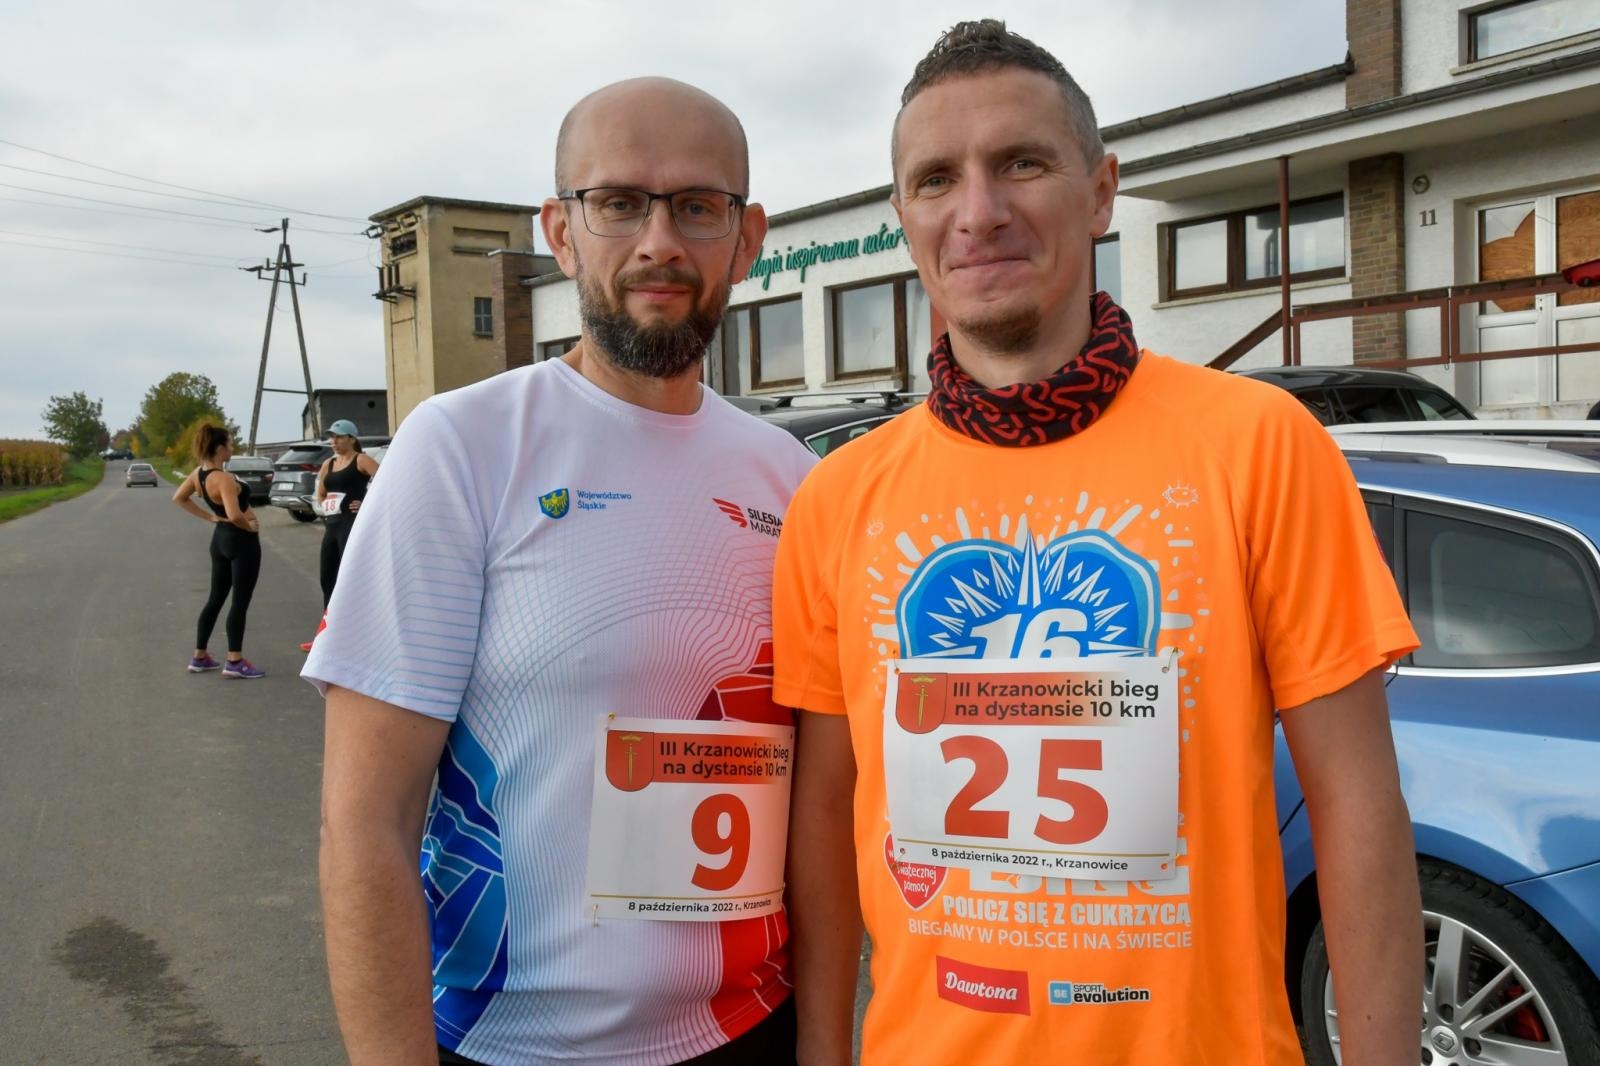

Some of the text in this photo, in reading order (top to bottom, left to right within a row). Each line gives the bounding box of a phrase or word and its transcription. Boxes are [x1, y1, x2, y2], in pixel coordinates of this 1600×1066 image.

[1419, 209, 1437, 227] 11
[786, 241, 859, 283] inspirowana
[577, 489, 632, 501] Województwo
[970, 608, 1088, 659] 16
[953, 680, 1159, 700] III Krzanowicki bieg
[955, 700, 1156, 720] na dystansie 10 km
[660, 742, 789, 762] III Krzanowicki bieg
[663, 760, 787, 778] na dystansie 10 km
[940, 735, 1108, 845] 25
[691, 793, 751, 891] 9
[931, 848, 1129, 870] 8 października 2022 r., Krzanowice
[903, 880, 930, 898] pomocy
[628, 902, 636, 911] 8
[638, 902, 710, 913] października
[712, 903, 734, 912] 2022
[943, 895, 1193, 930] POLICZ SIĘ Z CUKRZYCĄ
[908, 918, 1193, 949] BIEGAMY W POLSCE I NA ŚWIECIE
[945, 971, 1018, 1001] Dawtona
[1073, 984, 1102, 993] SPORT
[1073, 987, 1150, 1004] evolution
